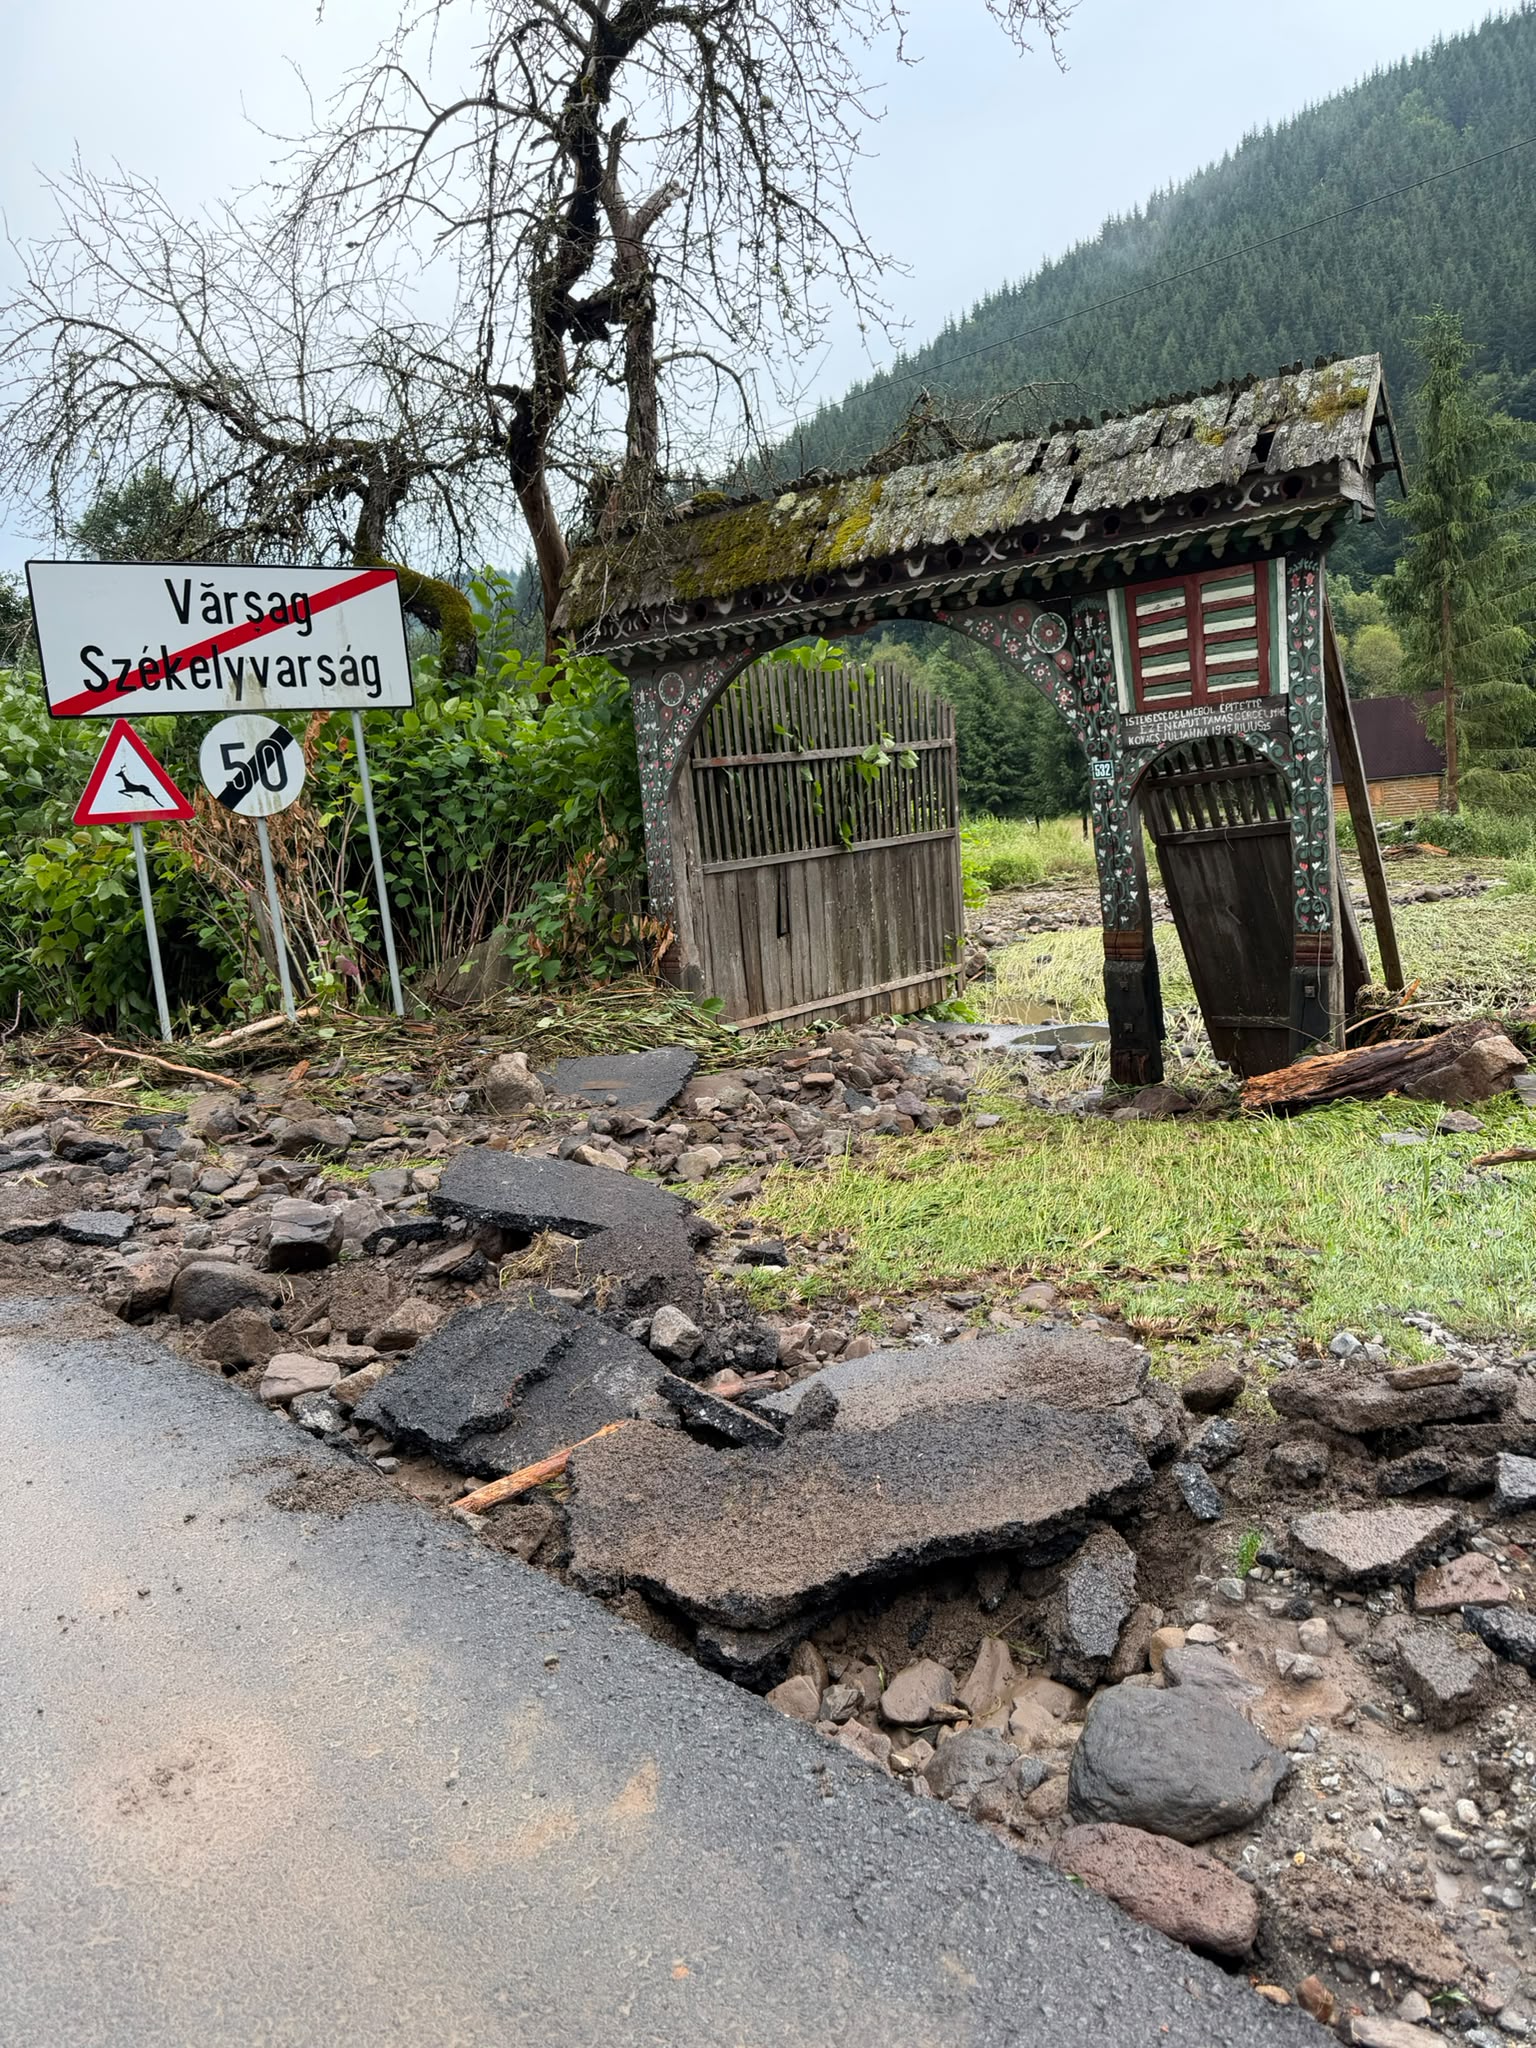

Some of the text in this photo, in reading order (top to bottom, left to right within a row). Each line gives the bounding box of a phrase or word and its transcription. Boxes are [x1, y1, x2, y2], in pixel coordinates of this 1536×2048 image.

[79, 644, 383, 702] Székelyvarság
[219, 738, 289, 793] 50
[1094, 763, 1111, 777] 532
